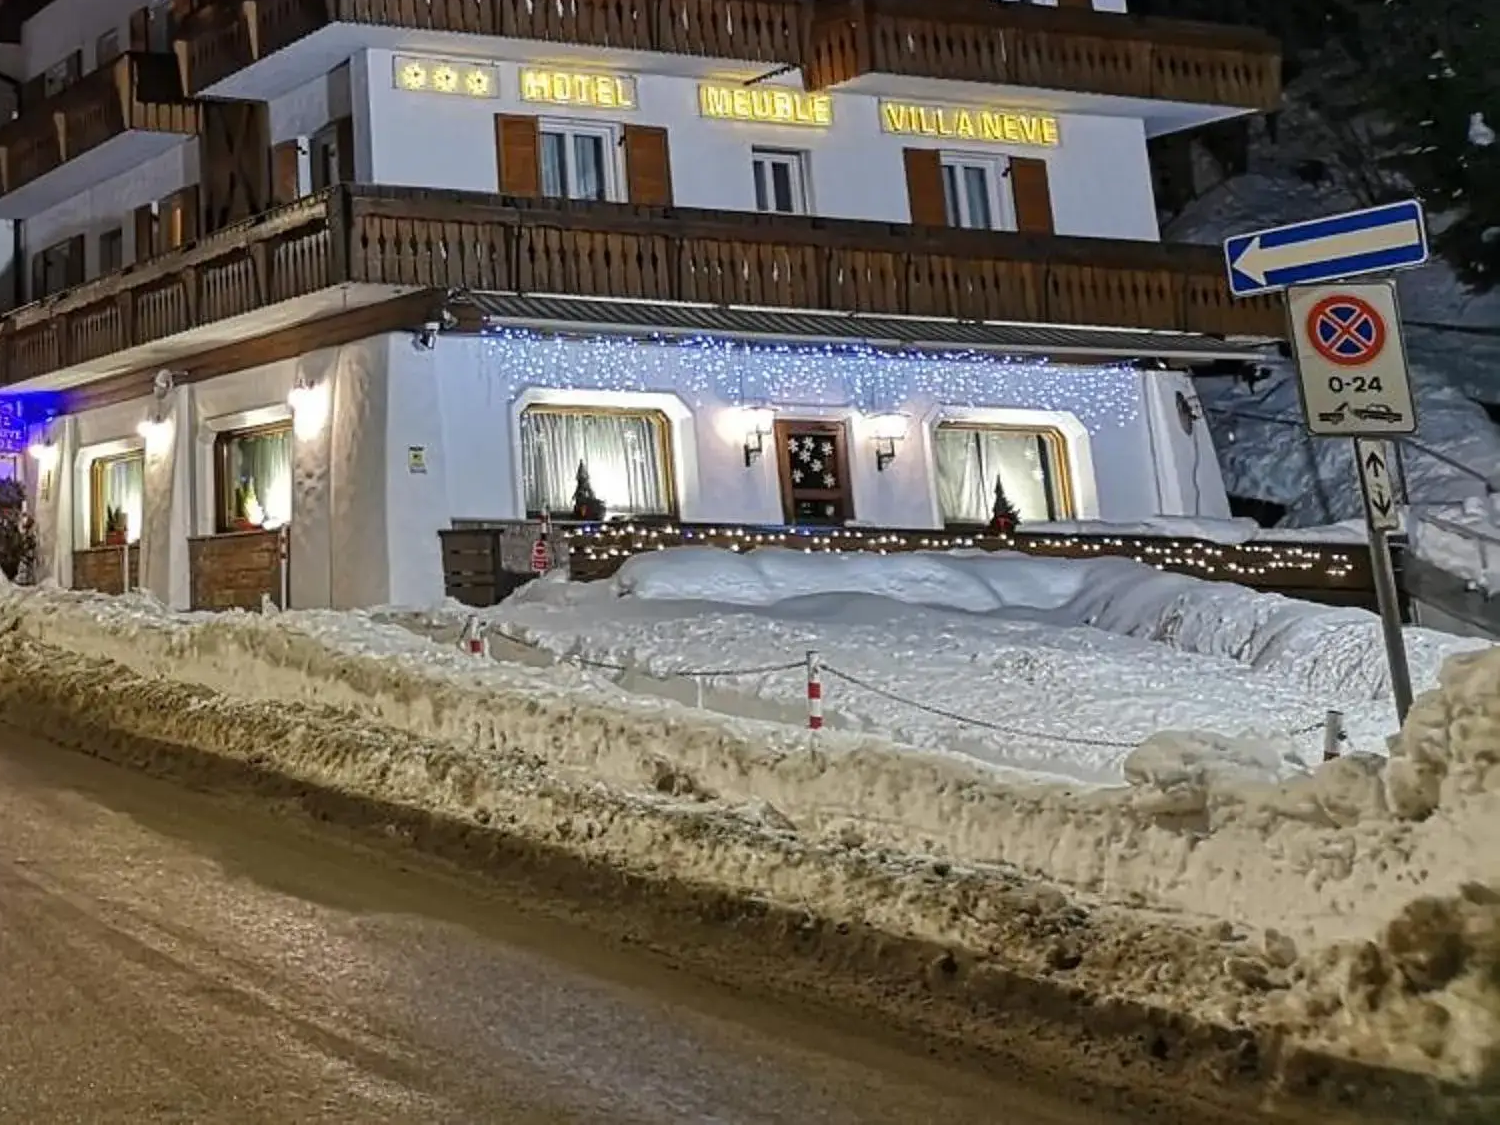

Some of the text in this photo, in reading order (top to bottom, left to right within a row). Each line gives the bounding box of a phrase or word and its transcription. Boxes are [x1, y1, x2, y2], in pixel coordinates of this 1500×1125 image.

[524, 72, 633, 107] HOTEL
[703, 86, 831, 124] MEUBLE
[1328, 376, 1382, 393] 0-24
